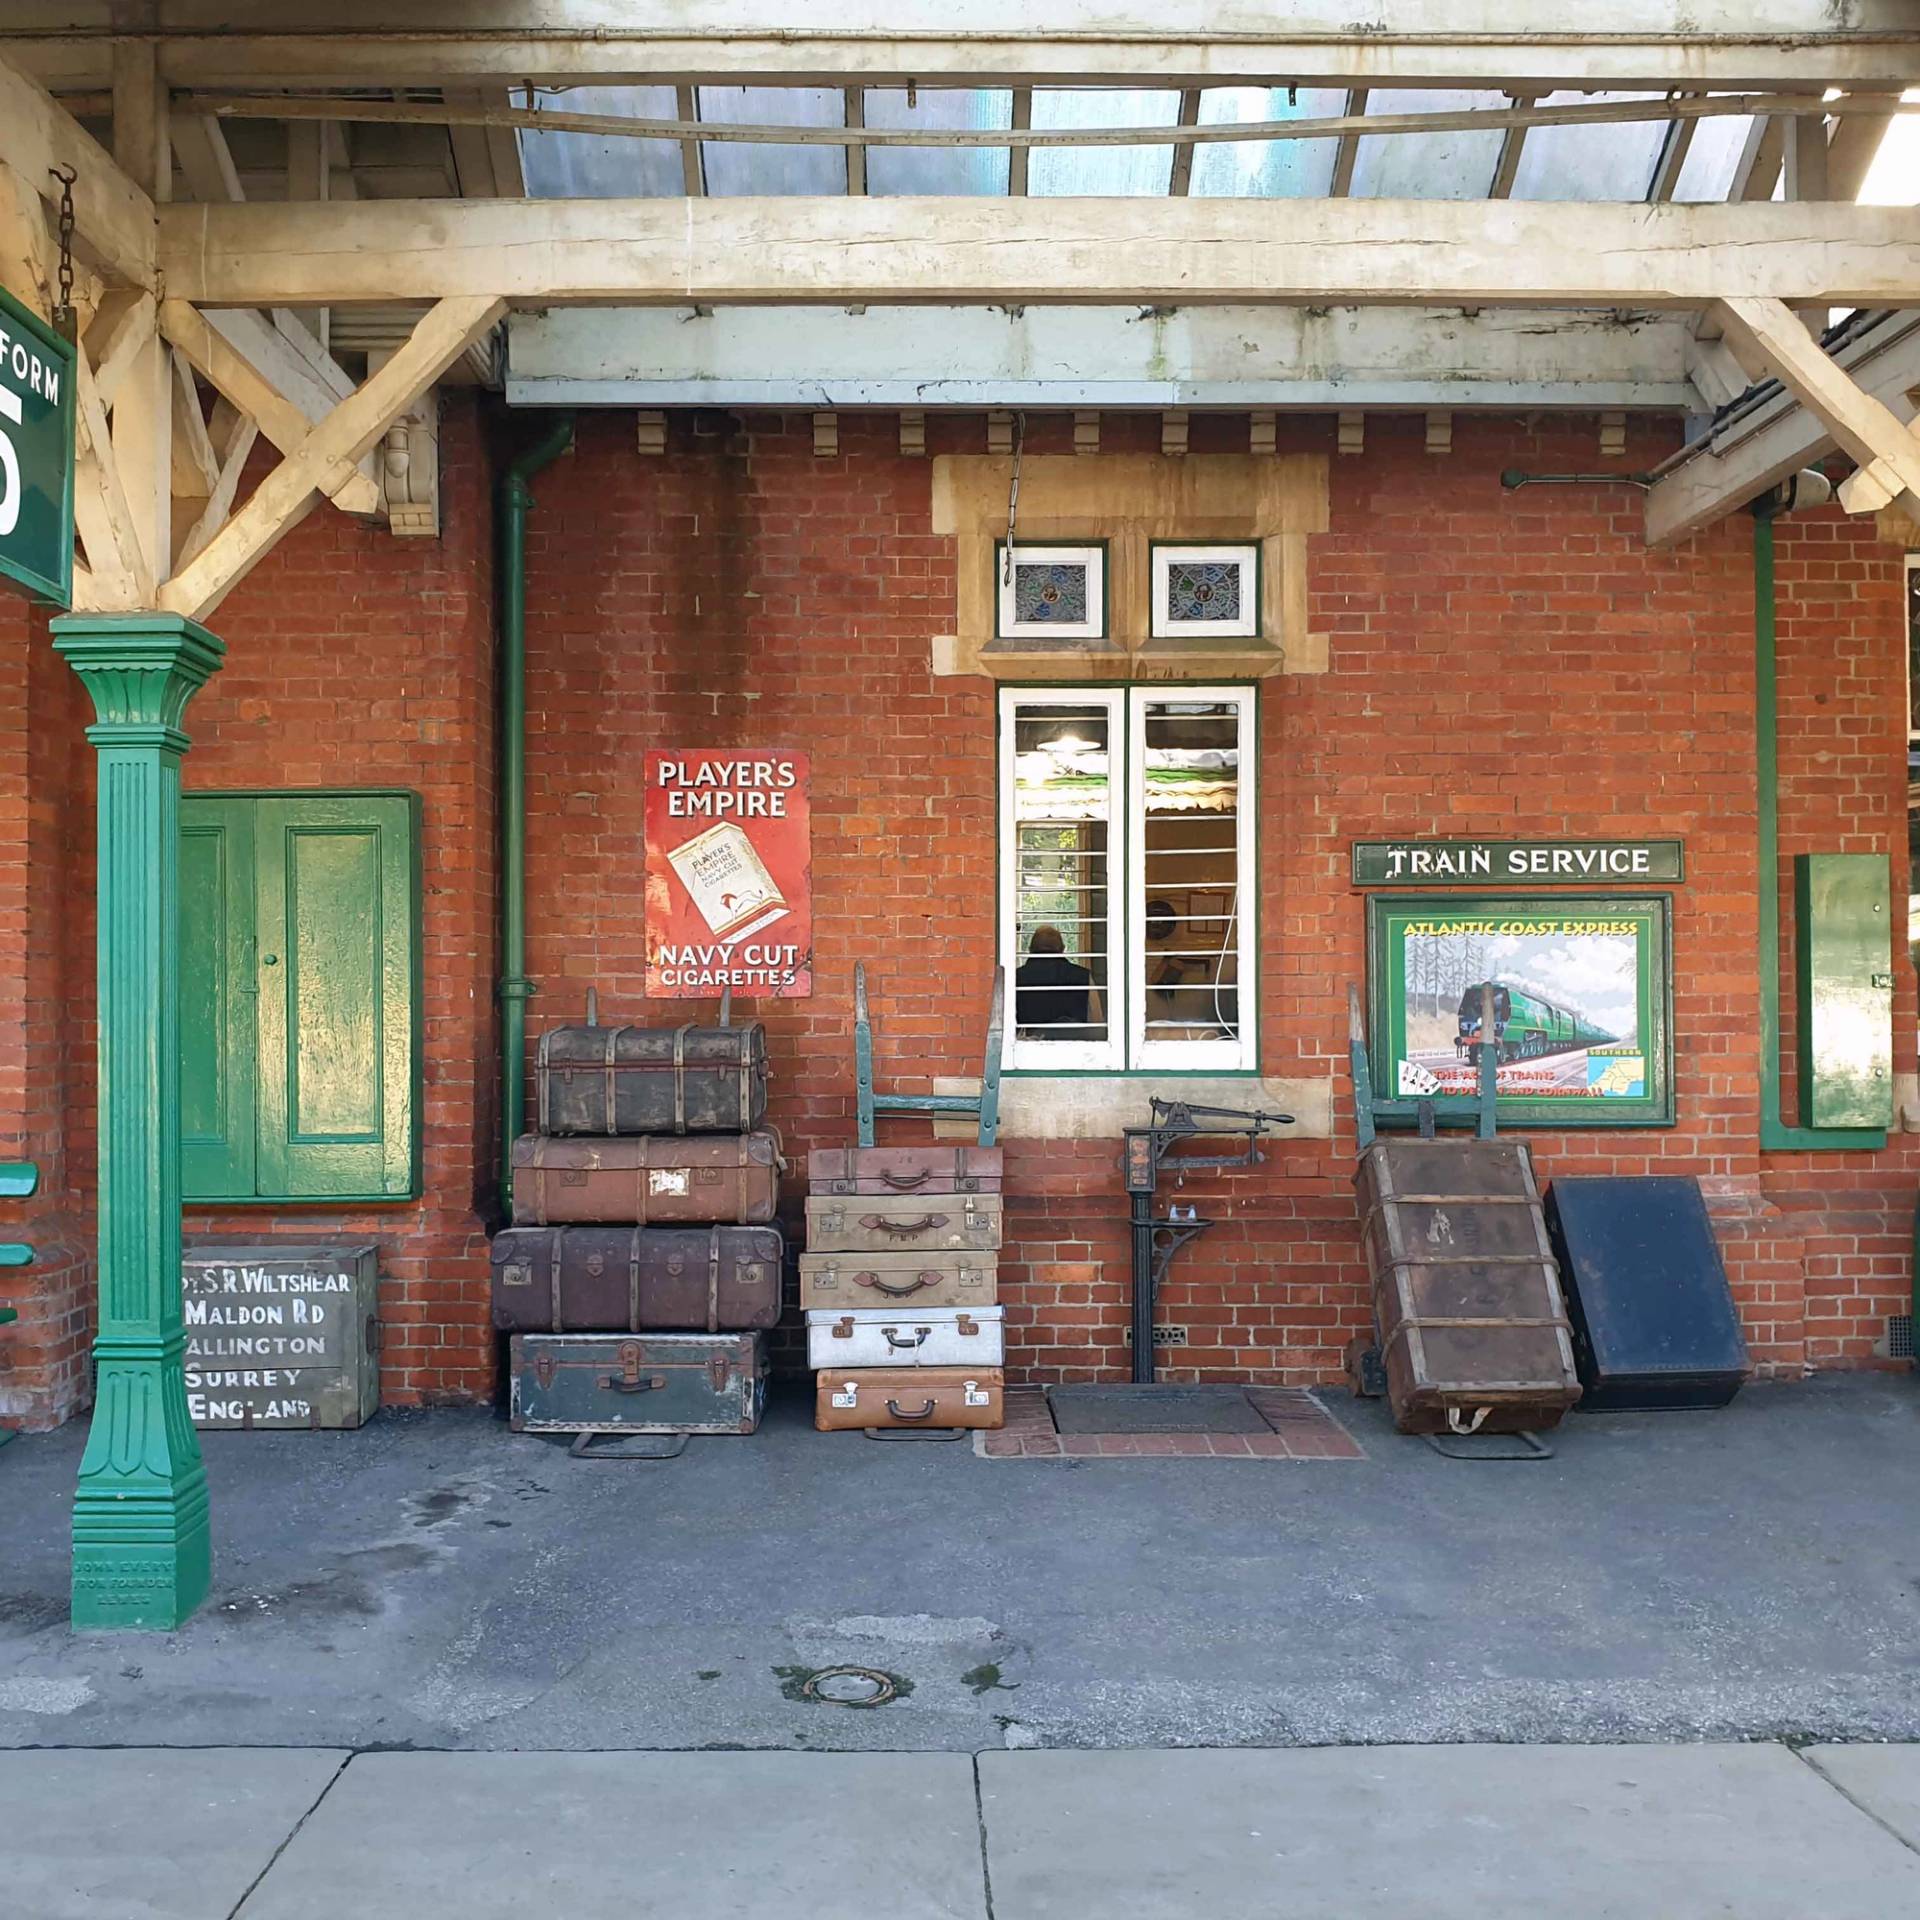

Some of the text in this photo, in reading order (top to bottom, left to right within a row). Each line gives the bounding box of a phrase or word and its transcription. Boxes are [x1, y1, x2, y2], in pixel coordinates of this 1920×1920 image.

[658, 760, 796, 787] PLAYER'S
[668, 791, 787, 817] EMPIRE
[692, 843, 731, 869] PLAYER'S
[696, 851, 735, 877] EMPIRE
[1388, 849, 1650, 873] TRAIN SERVICE
[1403, 921, 1638, 936] ATLANTIC COAST EXPRESS
[659, 945, 798, 966] NAVY CUT
[661, 970, 796, 986] CIGARETTES
[185, 1300, 283, 1325] MALDON
[183, 1337, 326, 1355] ALLINGTON
[185, 1362, 302, 1388] SURREY
